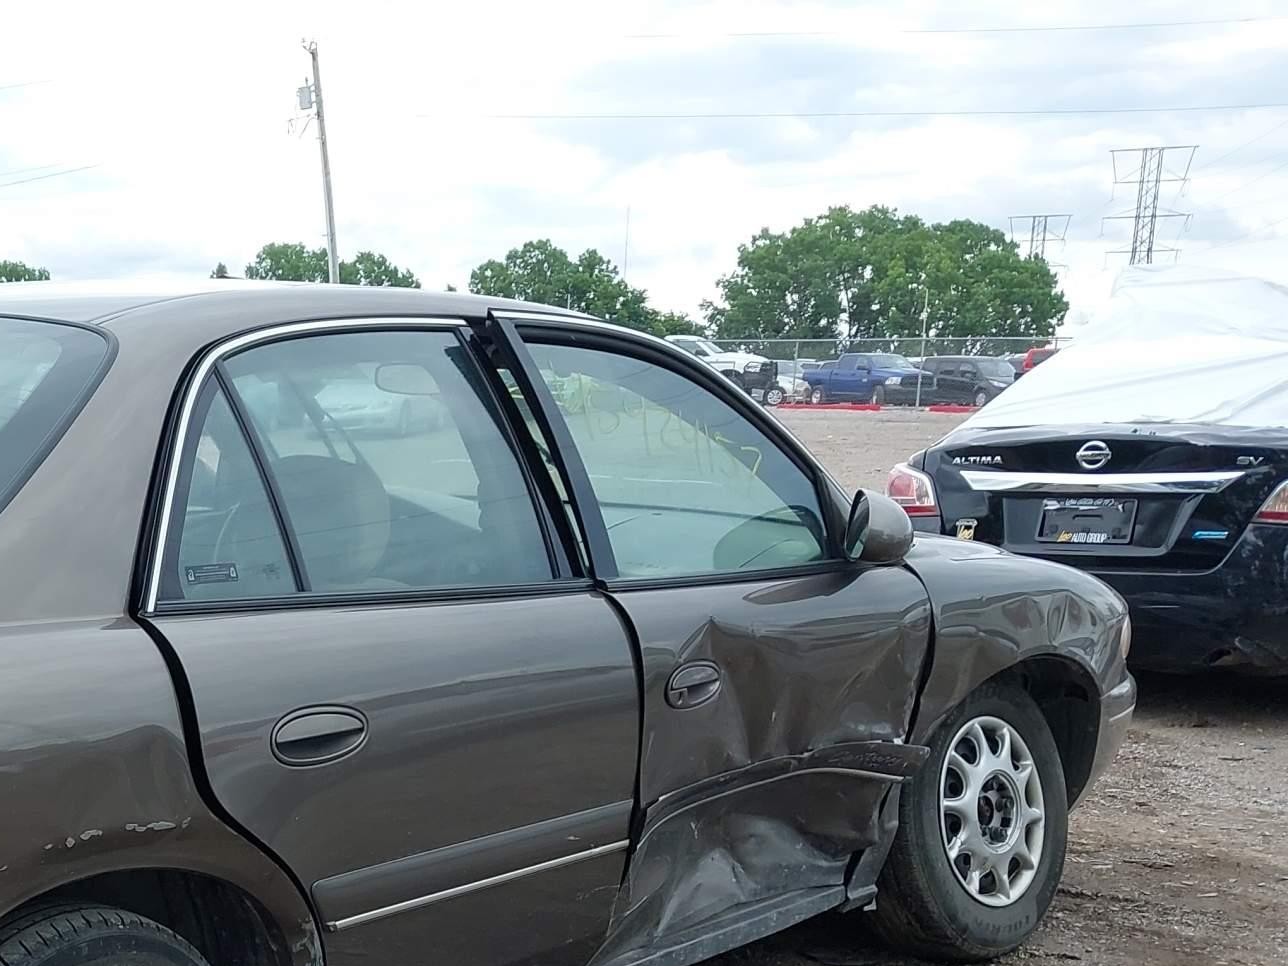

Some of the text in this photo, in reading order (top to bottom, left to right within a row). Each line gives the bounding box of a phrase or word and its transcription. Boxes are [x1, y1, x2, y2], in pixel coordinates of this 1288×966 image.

[952, 455, 1003, 465] ALTIMA
[1236, 455, 1265, 465] SV
[1071, 532, 1087, 543] AUTO
[1086, 532, 1108, 543] GROUP
